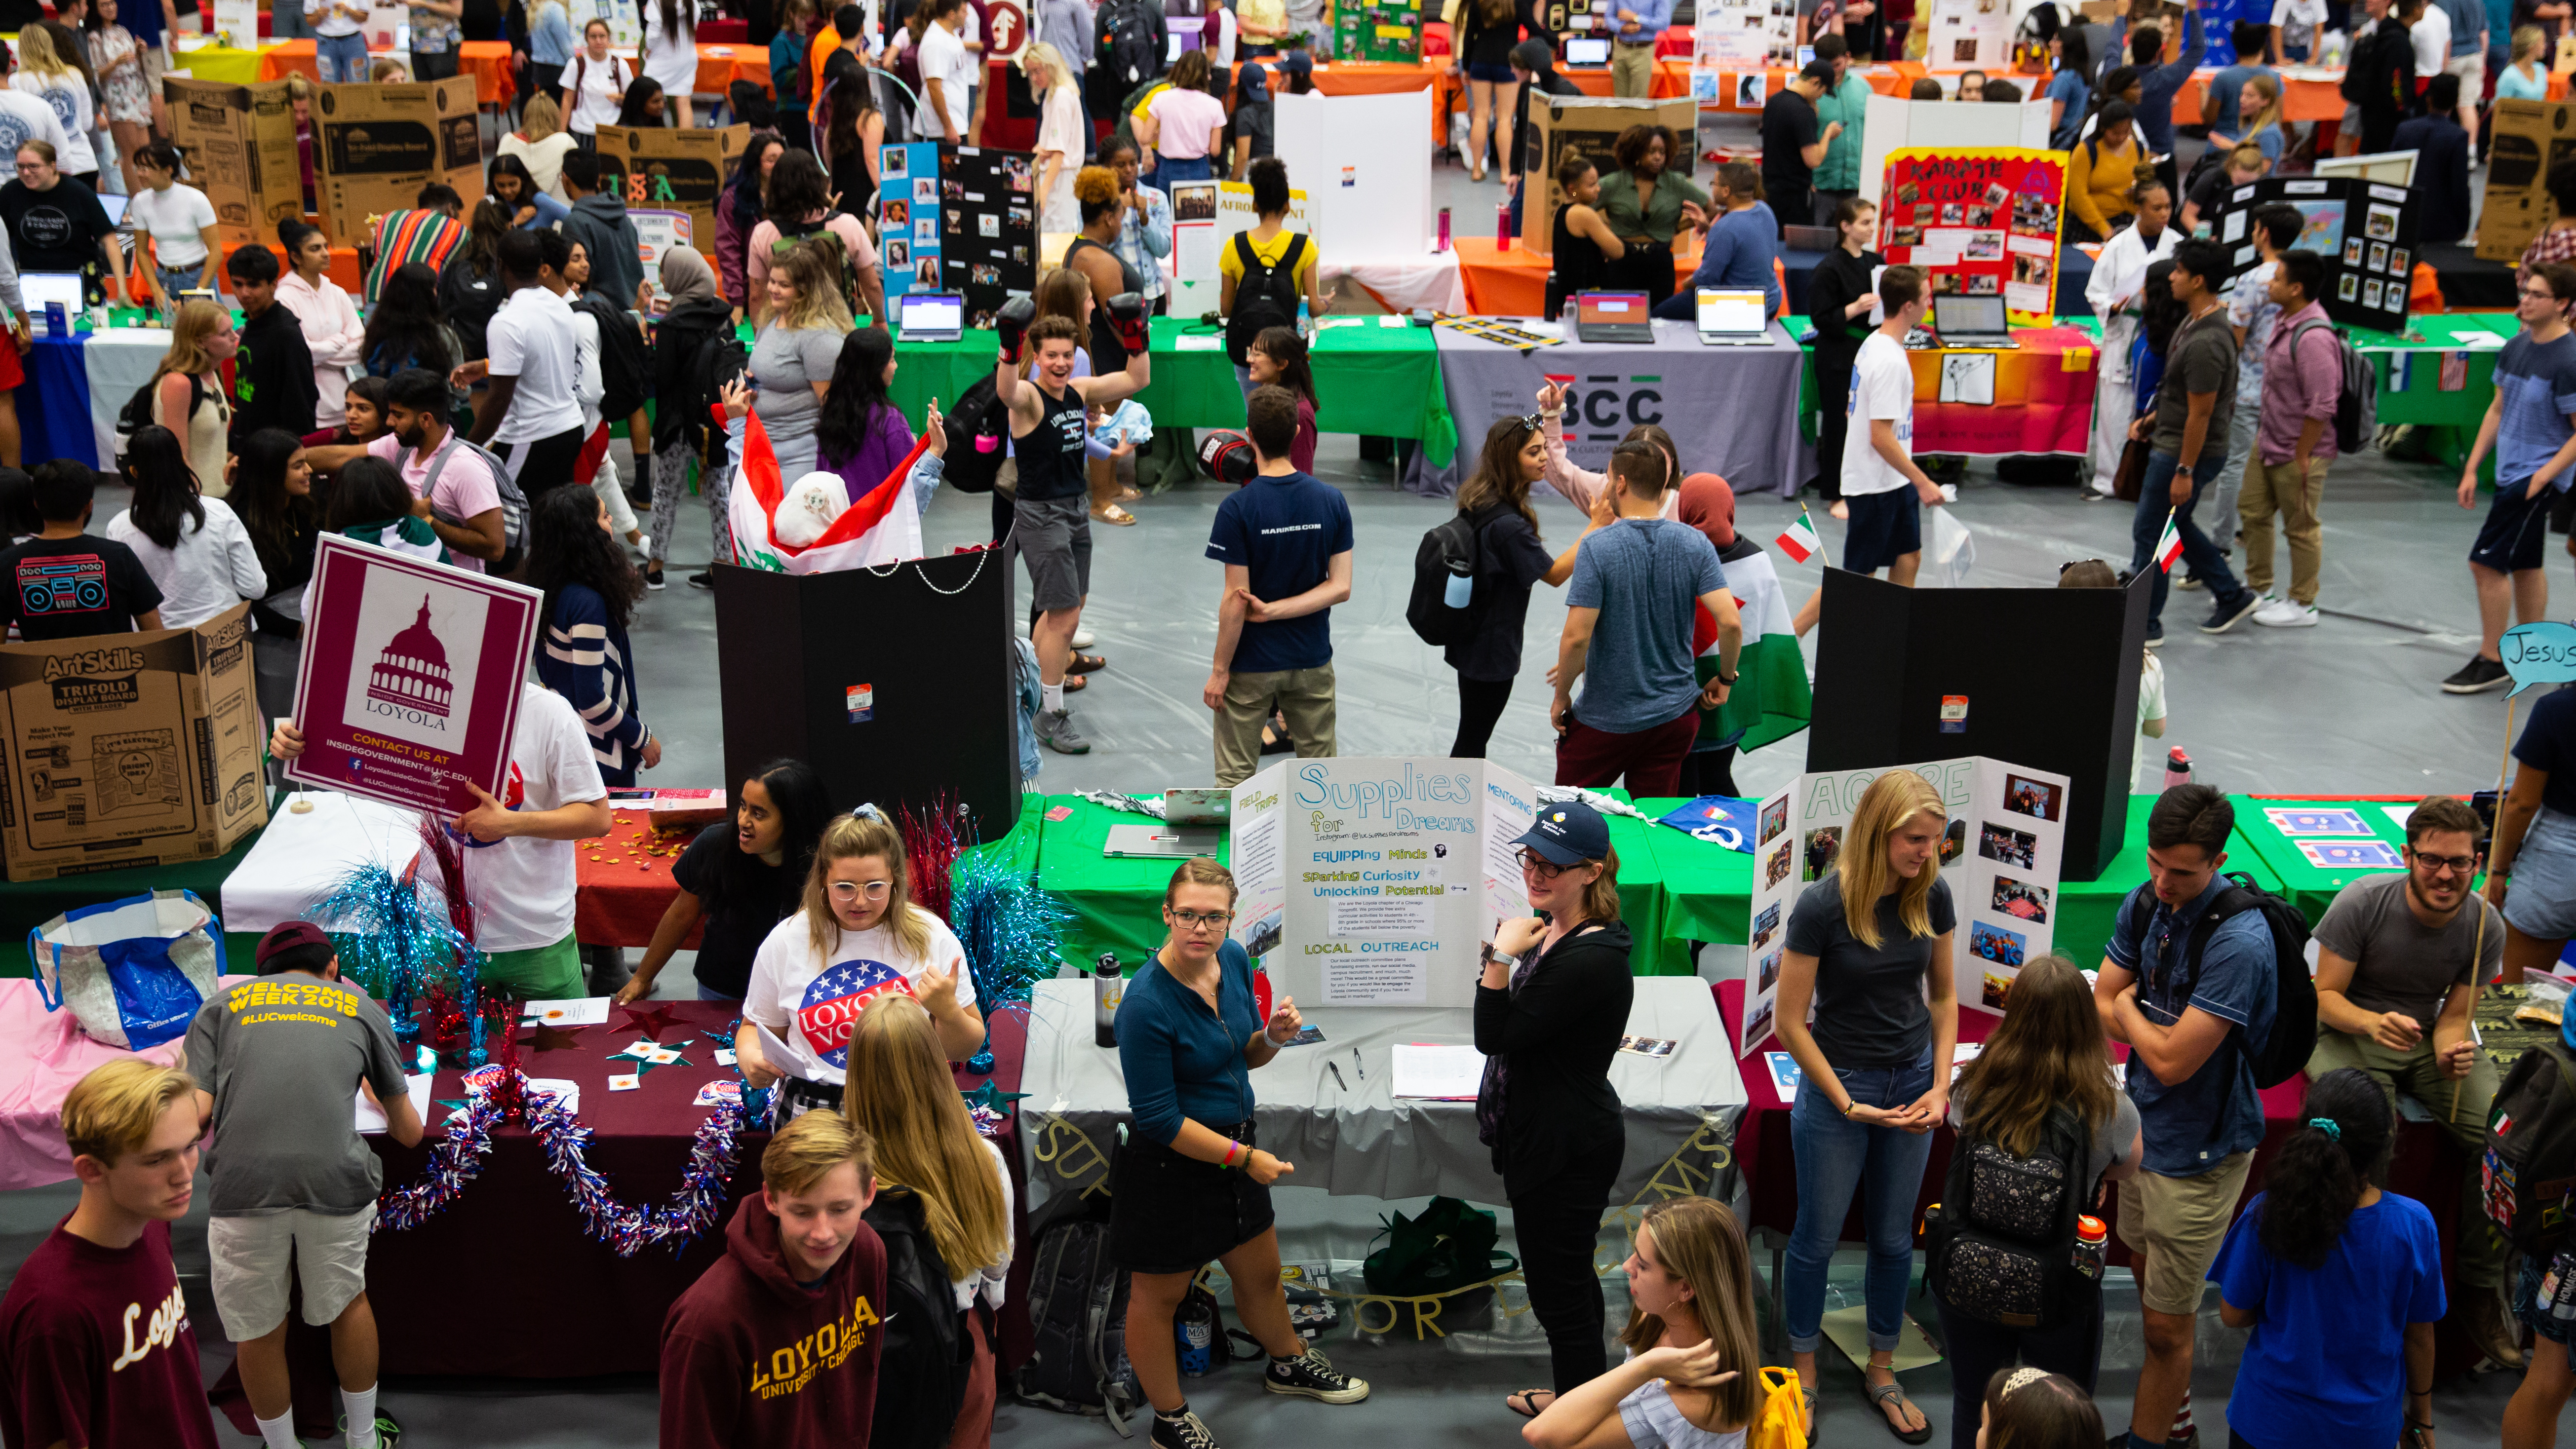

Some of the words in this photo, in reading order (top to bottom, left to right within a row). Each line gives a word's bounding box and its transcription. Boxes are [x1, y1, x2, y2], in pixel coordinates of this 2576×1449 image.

[1910, 160, 2002, 182] KARATE
[1927, 182, 1984, 201] CLUB
[1261, 524, 1321, 534] MARINES.COM
[206, 619, 246, 650] ArtSkills
[213, 645, 240, 666] TRIFOLD
[2506, 632, 2576, 667] Jesus
[43, 647, 145, 677] ArtSkills
[55, 694, 99, 707] DISPLAY
[101, 691, 137, 701] BOARD
[60, 681, 129, 697] TRIFOLD
[368, 690, 394, 701] INSIDE
[396, 698, 448, 715] GOVERNMENT
[366, 699, 446, 731] LOYOLA
[107, 740, 121, 749] IT'S
[352, 732, 411, 755] CONTACT
[414, 749, 430, 761] US
[433, 754, 450, 764] AT
[326, 739, 472, 782] INSIDEGOVERNMENT@LUC.EDU
[1239, 791, 1261, 810] FIELD
[1294, 763, 1471, 819] Supplies
[1488, 783, 1532, 816] MENTORING
[1804, 762, 1972, 819] AGPE
[1255, 794, 1278, 813] TRIPS
[116, 824, 186, 837] www.artskills.com
[1311, 810, 1344, 833] for
[1396, 807, 1476, 834] Dreams
[1541, 819, 1558, 830] Supplies
[1542, 825, 1560, 836] Dreams
[1314, 833, 1351, 841] Instagram:
[1389, 849, 1427, 860] Minds
[1363, 870, 1420, 881] Curiosity
[1314, 885, 1379, 897] Unlocking
[1305, 943, 1352, 954] LOCAL
[1361, 941, 1439, 953] OUTREACH
[229, 992, 298, 1013] WEEK
[303, 993, 357, 1017] 2019
[231, 982, 359, 1008] WELCOME
[147, 1018, 169, 1030] Office
[241, 1012, 338, 1028] #LUCwelcome
[814, 1018, 855, 1046] VO
[113, 1286, 185, 1372] Loyo
[1188, 1324, 1209, 1336] MAT
[750, 1296, 879, 1392] LOYOLA
